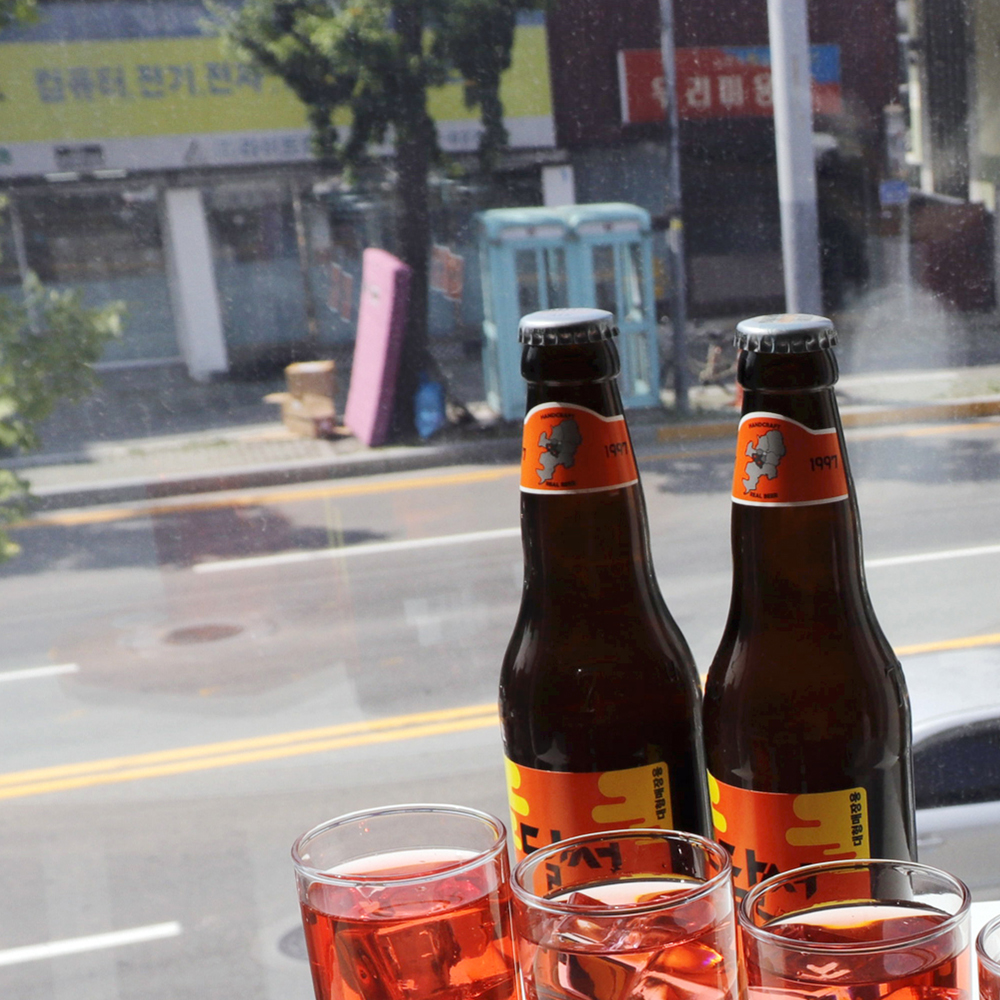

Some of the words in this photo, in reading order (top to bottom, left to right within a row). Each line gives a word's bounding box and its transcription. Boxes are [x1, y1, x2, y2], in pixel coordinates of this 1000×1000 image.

[605, 441, 629, 458] 1997
[810, 454, 838, 472] 1997
[652, 766, 666, 821] 대형매장용
[849, 791, 864, 847] 대형매장용
